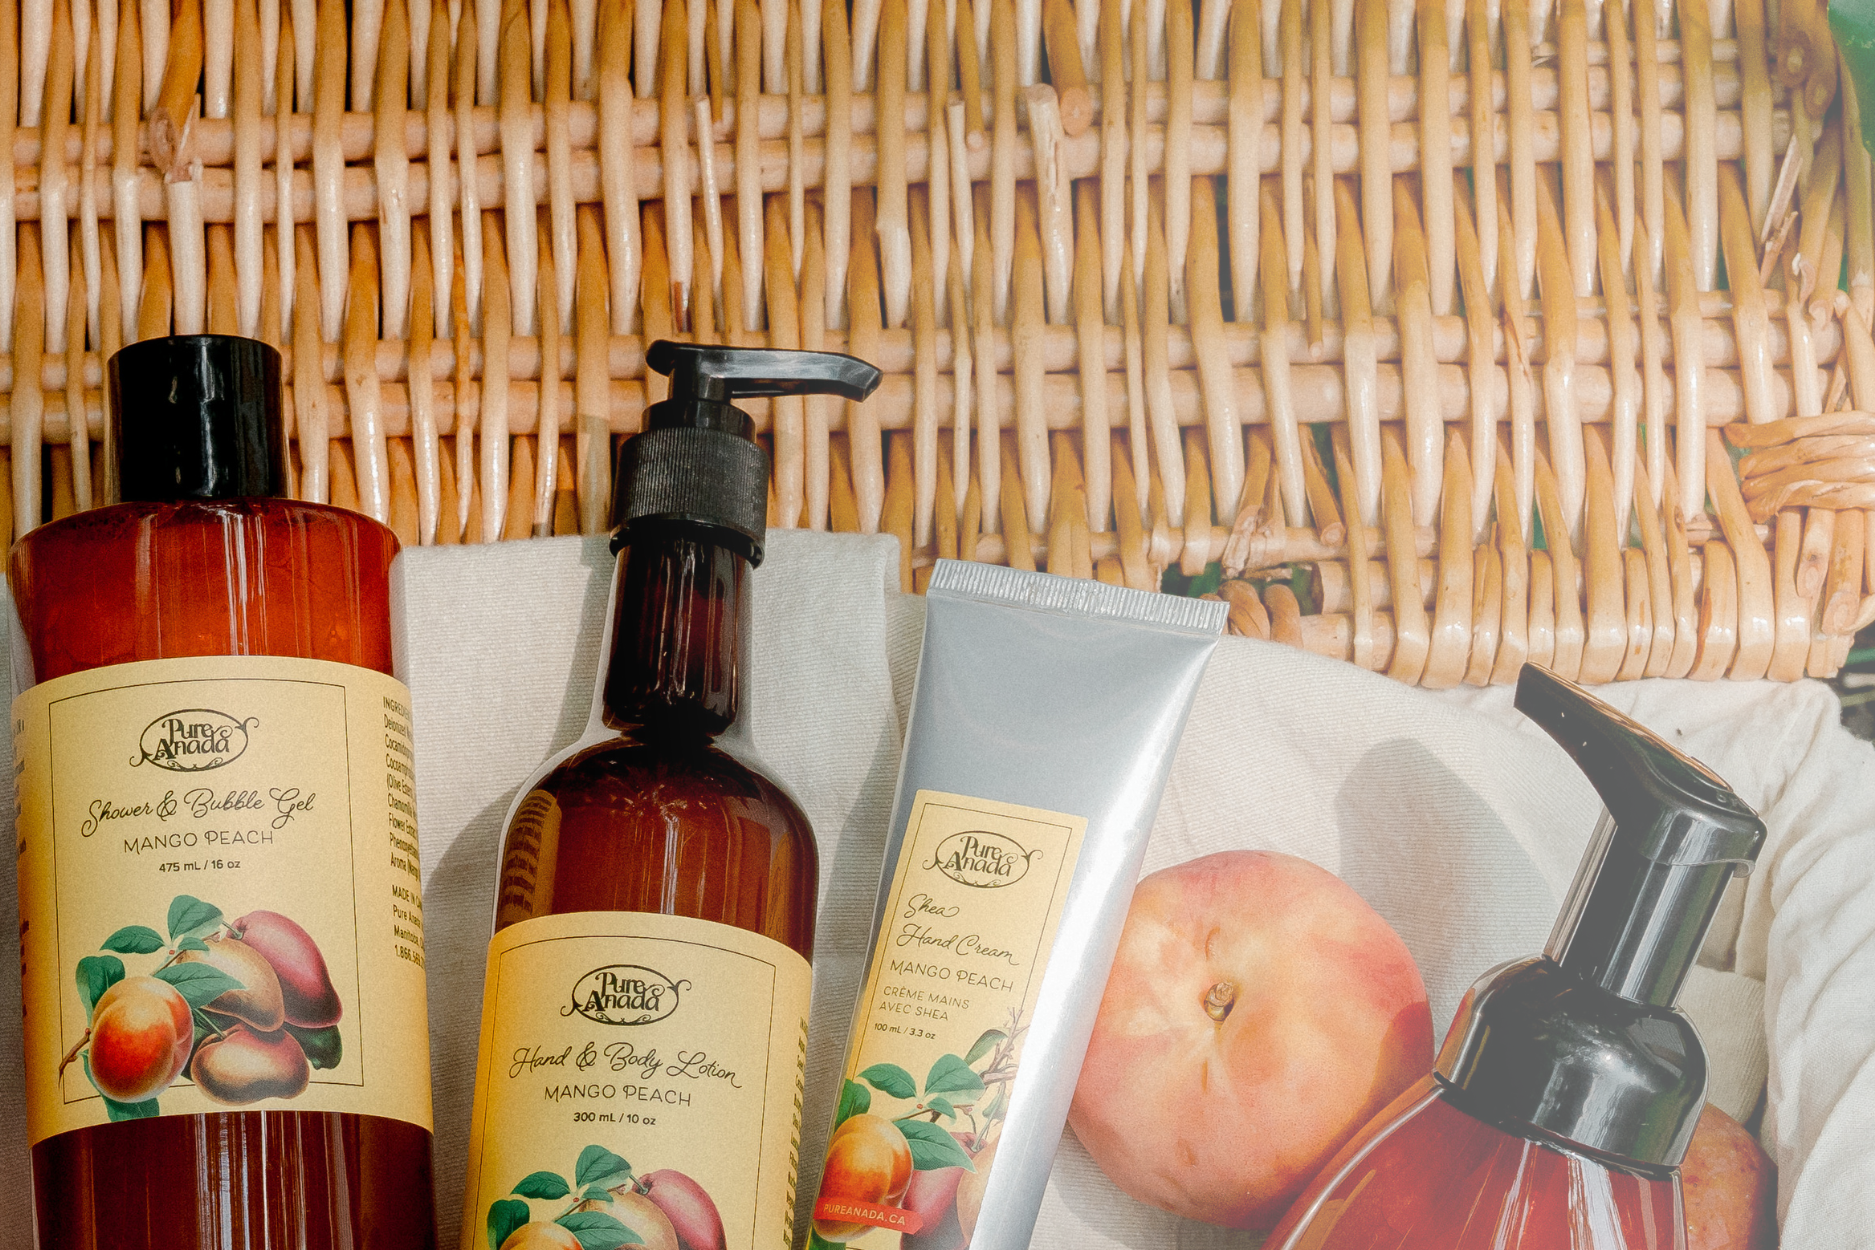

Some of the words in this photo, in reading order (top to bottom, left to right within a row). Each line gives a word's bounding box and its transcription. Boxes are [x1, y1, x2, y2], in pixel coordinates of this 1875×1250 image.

[162, 718, 213, 746] Pure
[152, 735, 230, 760] Anada
[81, 798, 153, 838] Shower
[156, 790, 178, 821] &
[184, 788, 265, 818] Bubble
[269, 787, 315, 829] Gel
[124, 833, 198, 854] MANGO
[204, 830, 274, 846] PEACH
[959, 835, 1002, 862] Pure
[158, 862, 180, 873] 475
[183, 861, 201, 872] mL
[211, 860, 223, 870] 16
[227, 862, 241, 870] oz
[942, 852, 1012, 878] Anada
[392, 884, 409, 902] MADE
[393, 904, 407, 921] Pure
[903, 893, 960, 919] Shea
[896, 923, 957, 949] Hand
[955, 934, 1020, 966] Cream
[595, 971, 646, 998] Pure
[890, 959, 952, 982] MANGO
[956, 969, 1014, 994] PEACH
[584, 989, 660, 1012] Anada
[879, 1001, 912, 1018] AVEC
[915, 1007, 949, 1022] SHEA
[928, 993, 970, 1010] MAINS
[873, 1022, 888, 1032] 100
[889, 1024, 902, 1034] mL
[909, 1027, 923, 1038] 3.3
[925, 1031, 936, 1040] oz
[509, 1045, 572, 1078] Hand
[575, 1041, 597, 1071] &
[603, 1042, 663, 1079] Body
[666, 1050, 743, 1089] Lotion
[544, 1084, 616, 1102] MANGO
[622, 1085, 691, 1107] PEACH
[573, 1112, 596, 1122] 300
[598, 1112, 615, 1123] mL
[626, 1113, 640, 1125] 10
[643, 1116, 656, 1126] oz
[823, 1202, 907, 1226] PUREANADA.CA
